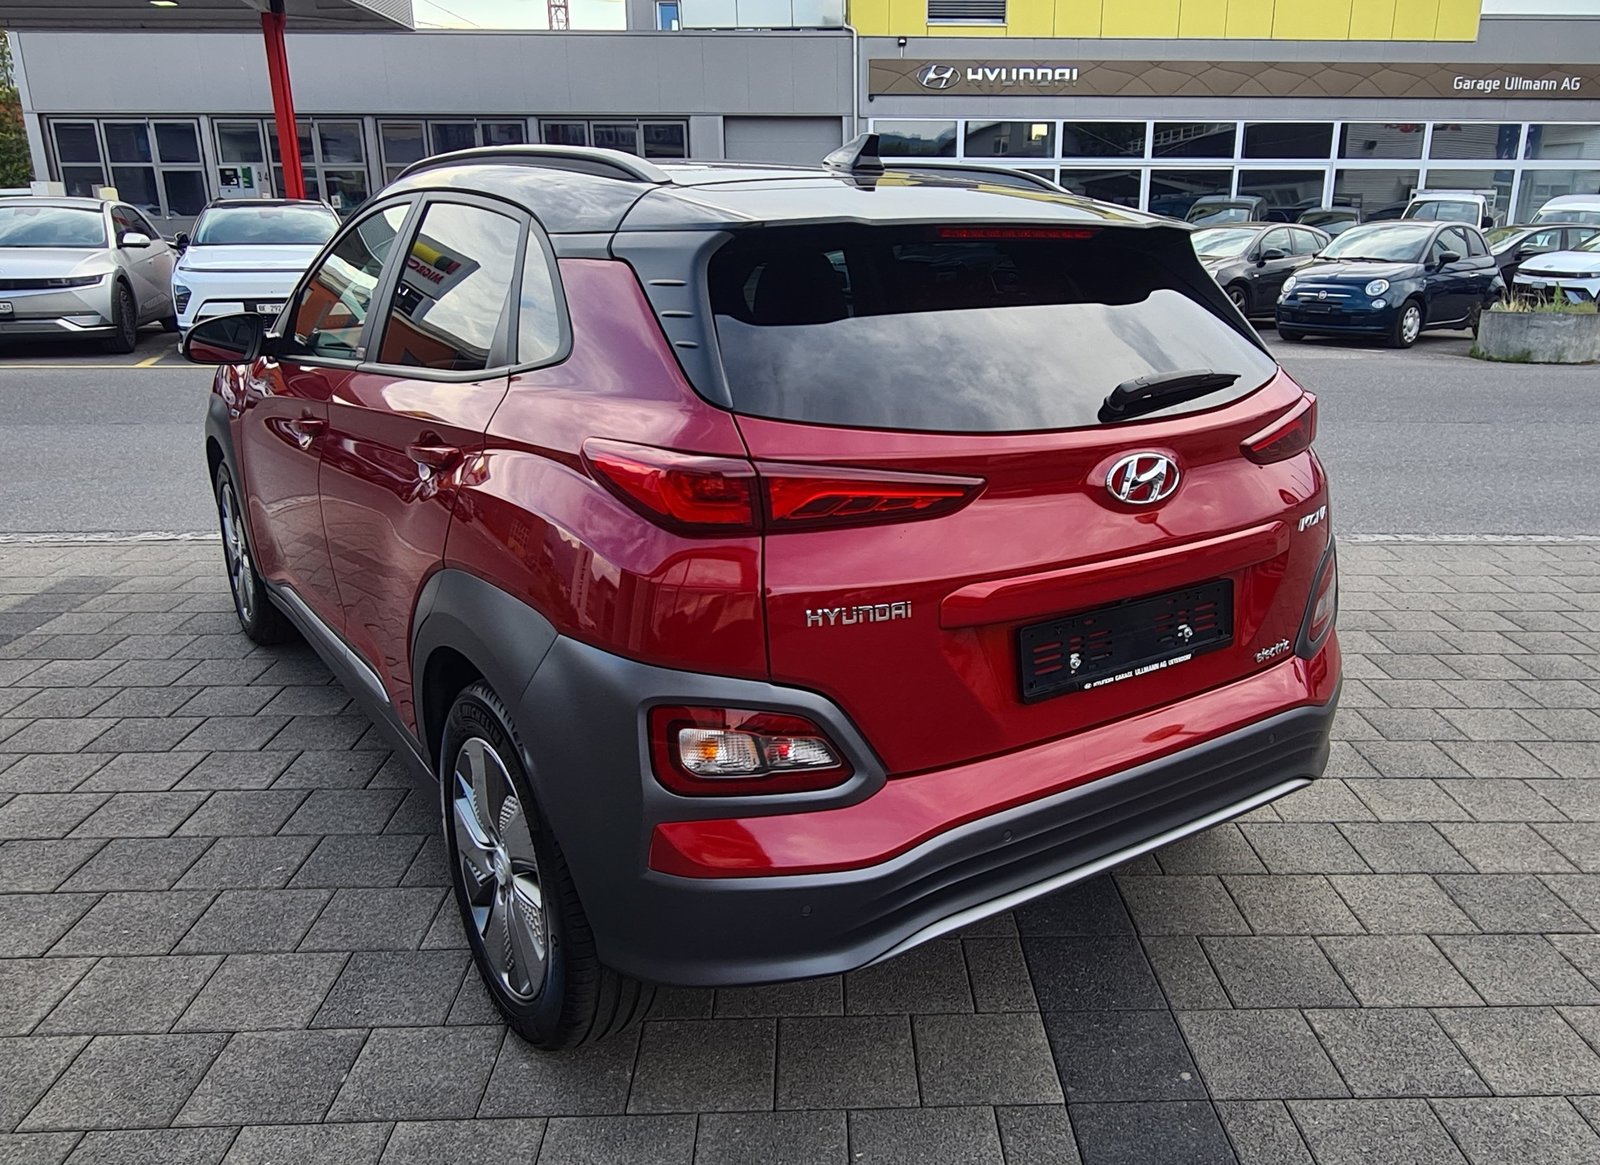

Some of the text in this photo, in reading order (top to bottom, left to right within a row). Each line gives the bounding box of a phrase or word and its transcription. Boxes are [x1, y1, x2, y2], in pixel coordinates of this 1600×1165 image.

[967, 67, 1078, 86] HYUNDAI
[1453, 77, 1581, 93] Garage Ullmann AG
[806, 601, 912, 627] HYUNDAI
